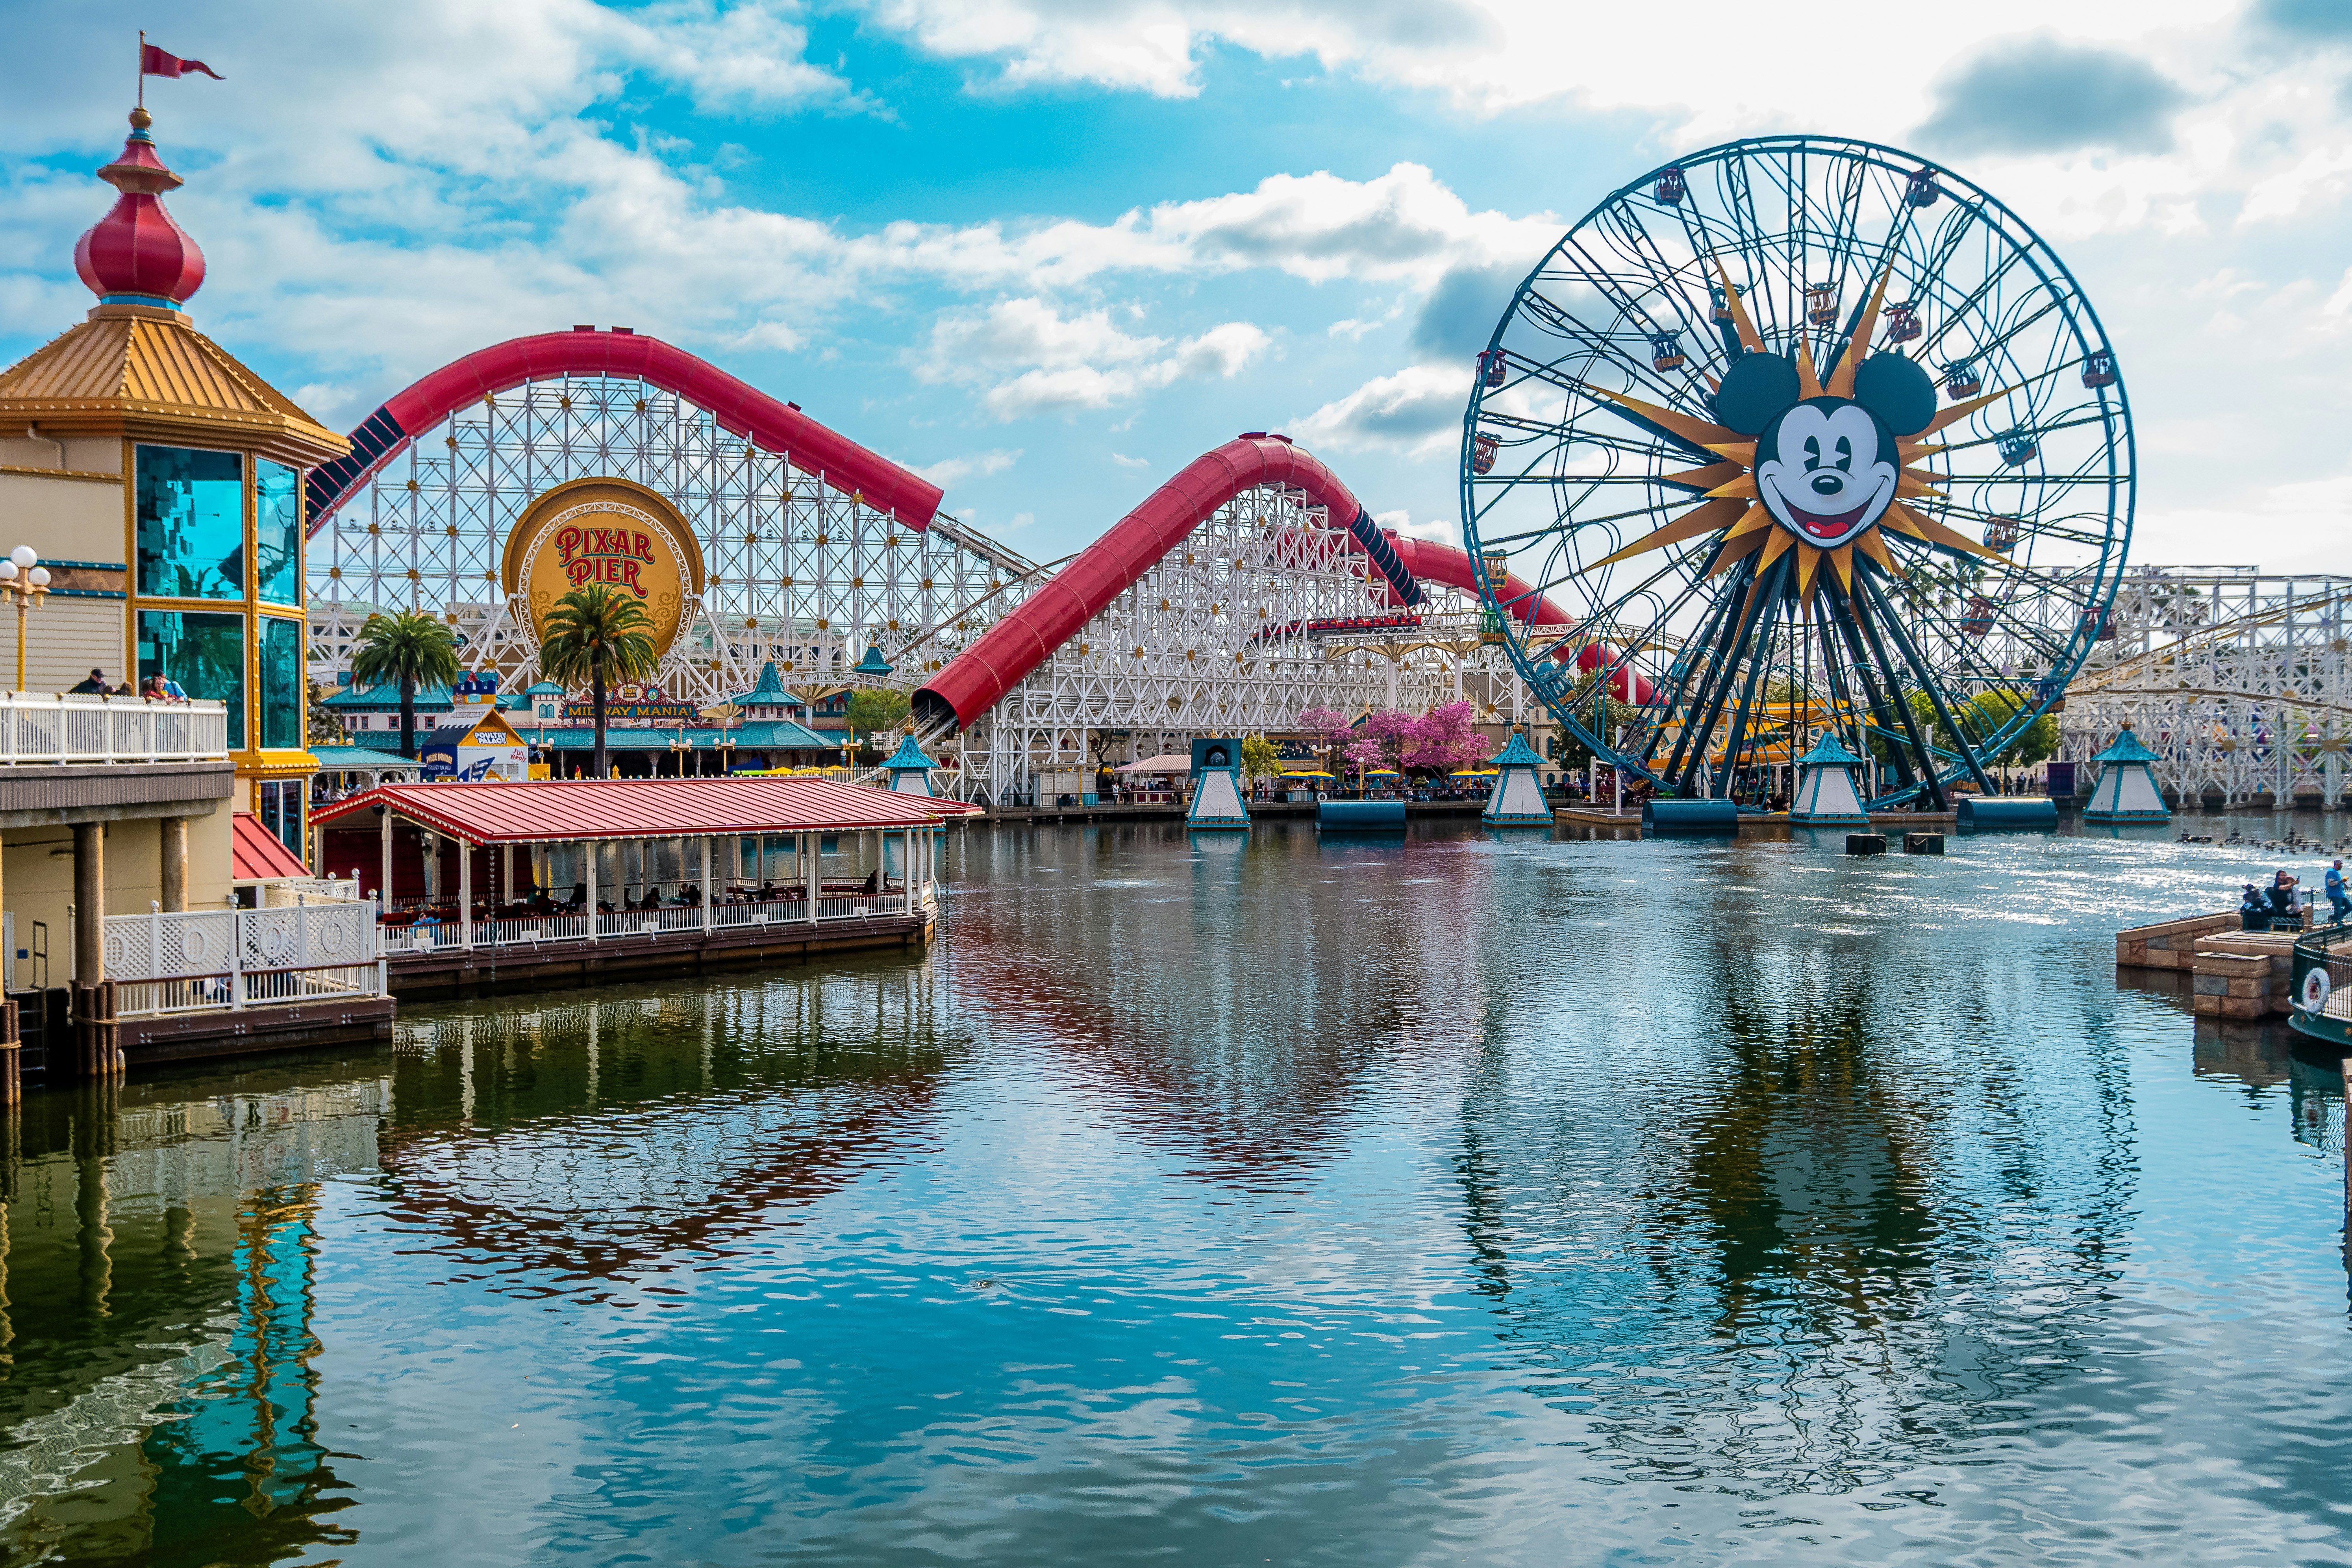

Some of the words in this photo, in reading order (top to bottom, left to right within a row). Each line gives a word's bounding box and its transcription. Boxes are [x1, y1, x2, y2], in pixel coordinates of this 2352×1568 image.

[555, 526, 655, 567] PIXAR
[566, 556, 648, 598] PIER
[637, 706, 692, 716] MANIA!
